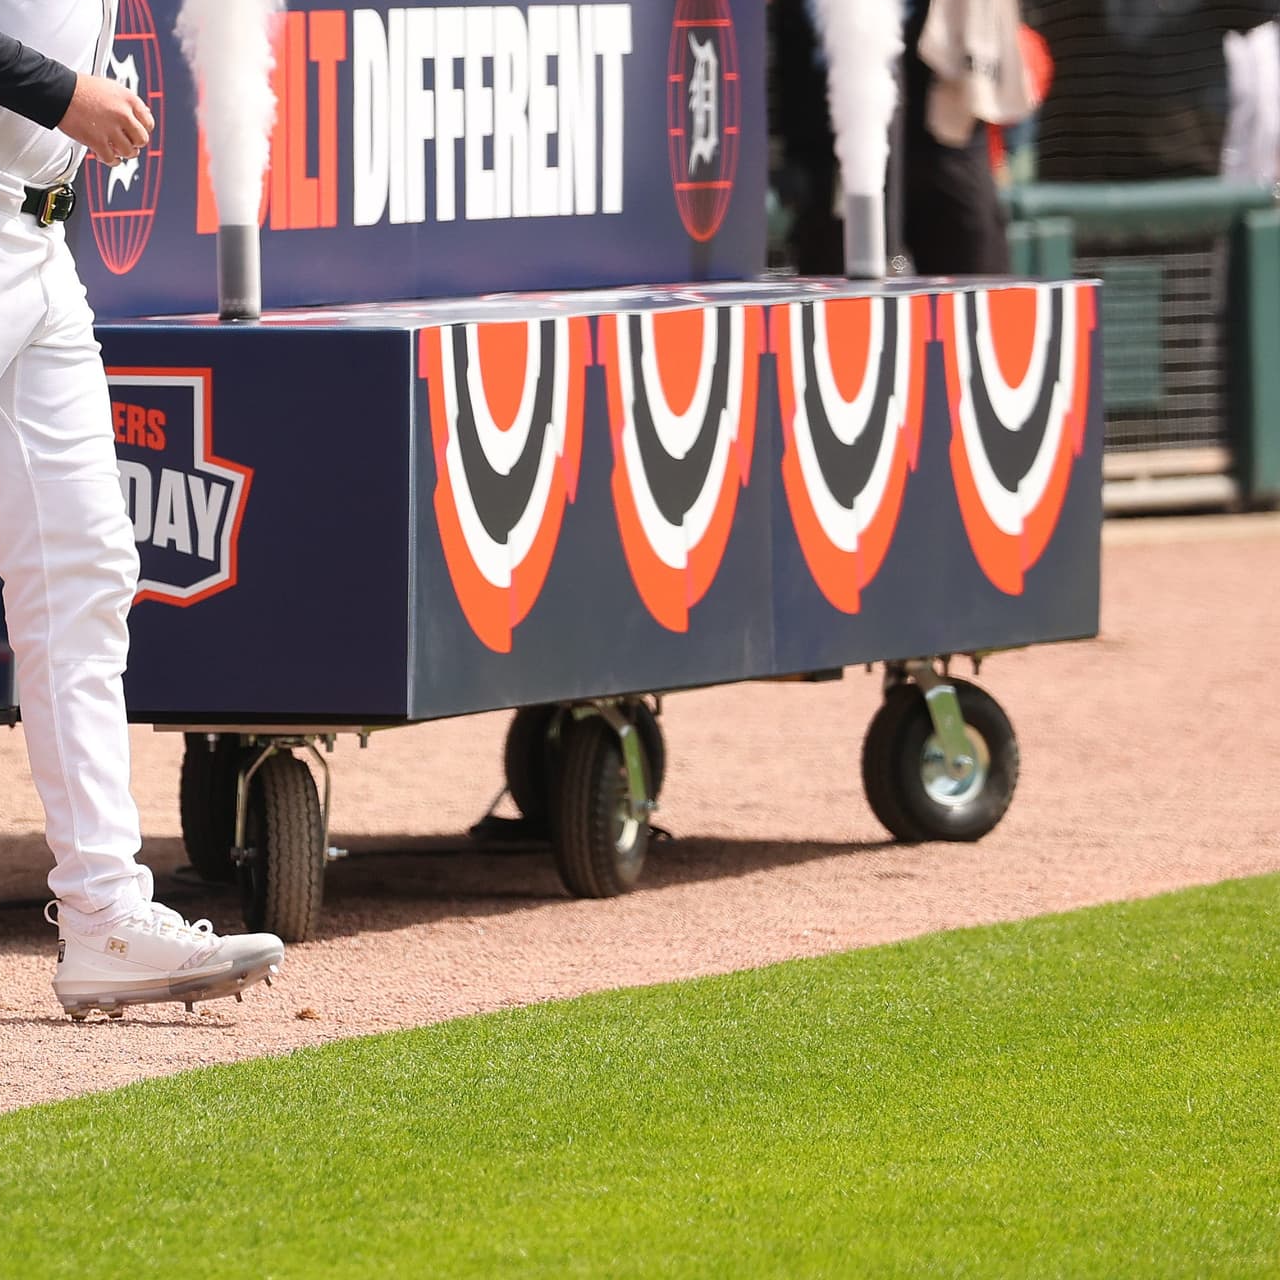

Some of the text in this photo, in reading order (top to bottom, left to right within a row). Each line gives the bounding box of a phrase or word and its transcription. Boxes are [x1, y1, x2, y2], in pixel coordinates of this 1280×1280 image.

[197, 10, 346, 234] ILT
[353, 3, 632, 226] DIFFERENT
[112, 402, 167, 451] ERS
[117, 459, 228, 562] DAY
